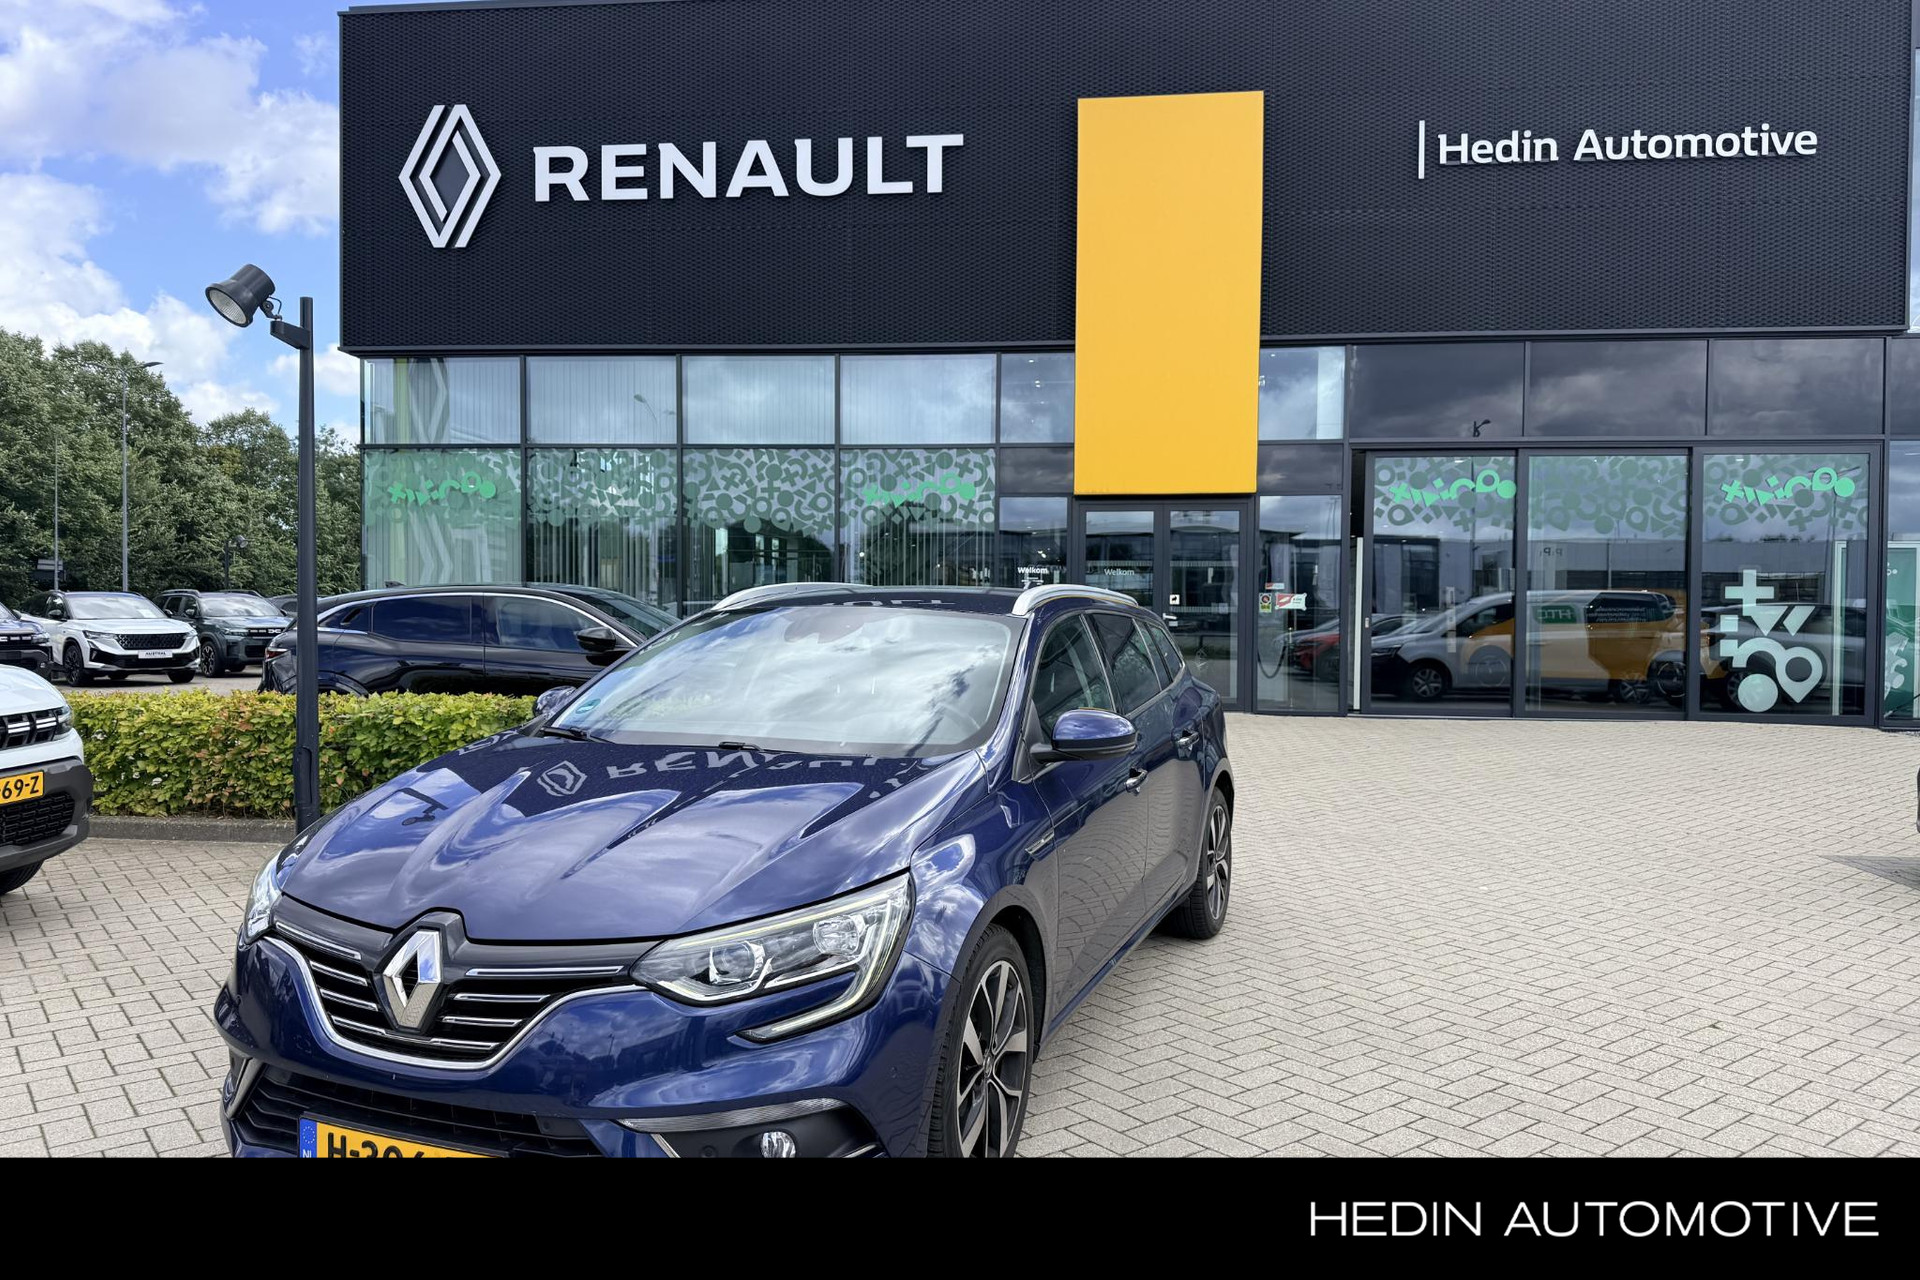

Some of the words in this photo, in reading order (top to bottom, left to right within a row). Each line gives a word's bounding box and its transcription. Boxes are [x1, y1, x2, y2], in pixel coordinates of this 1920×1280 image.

[1437, 130, 1559, 164] Hedin
[1573, 123, 1819, 161] Automotive
[533, 133, 965, 202] RENAULT
[1104, 568, 1135, 576] Welkom
